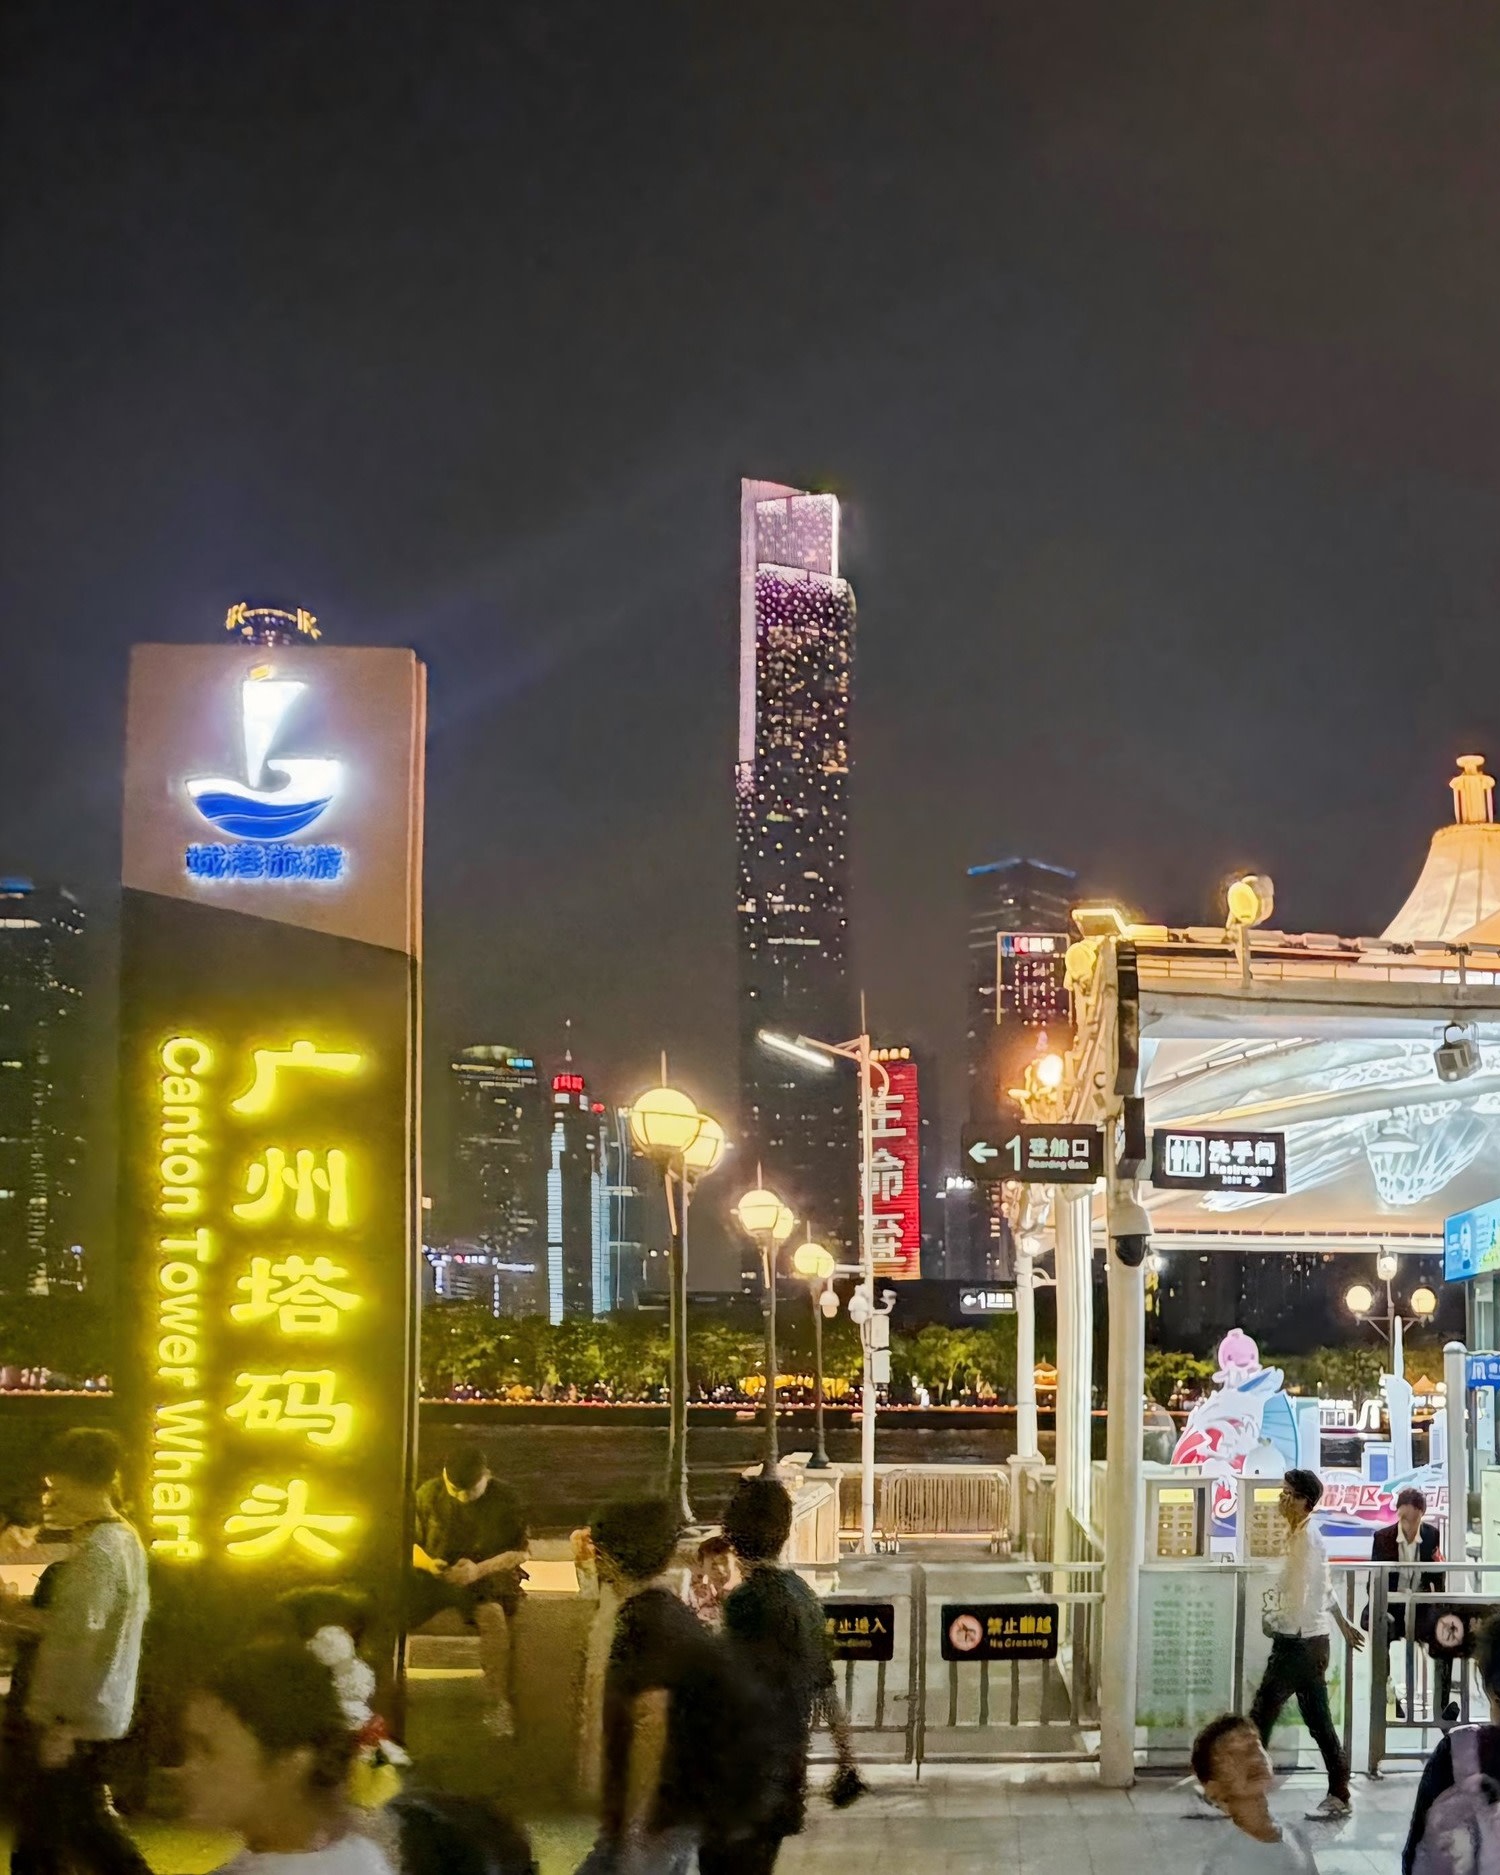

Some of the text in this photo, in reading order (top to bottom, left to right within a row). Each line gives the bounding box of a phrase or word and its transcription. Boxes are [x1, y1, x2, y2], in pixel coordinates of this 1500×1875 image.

[1005, 1134, 1089, 1172] 1 登船口
[1208, 1140, 1276, 1165] 洗手间
[151, 1036, 212, 1557] Canton Tower Wharf
[224, 1039, 363, 1559] 广州塔码头
